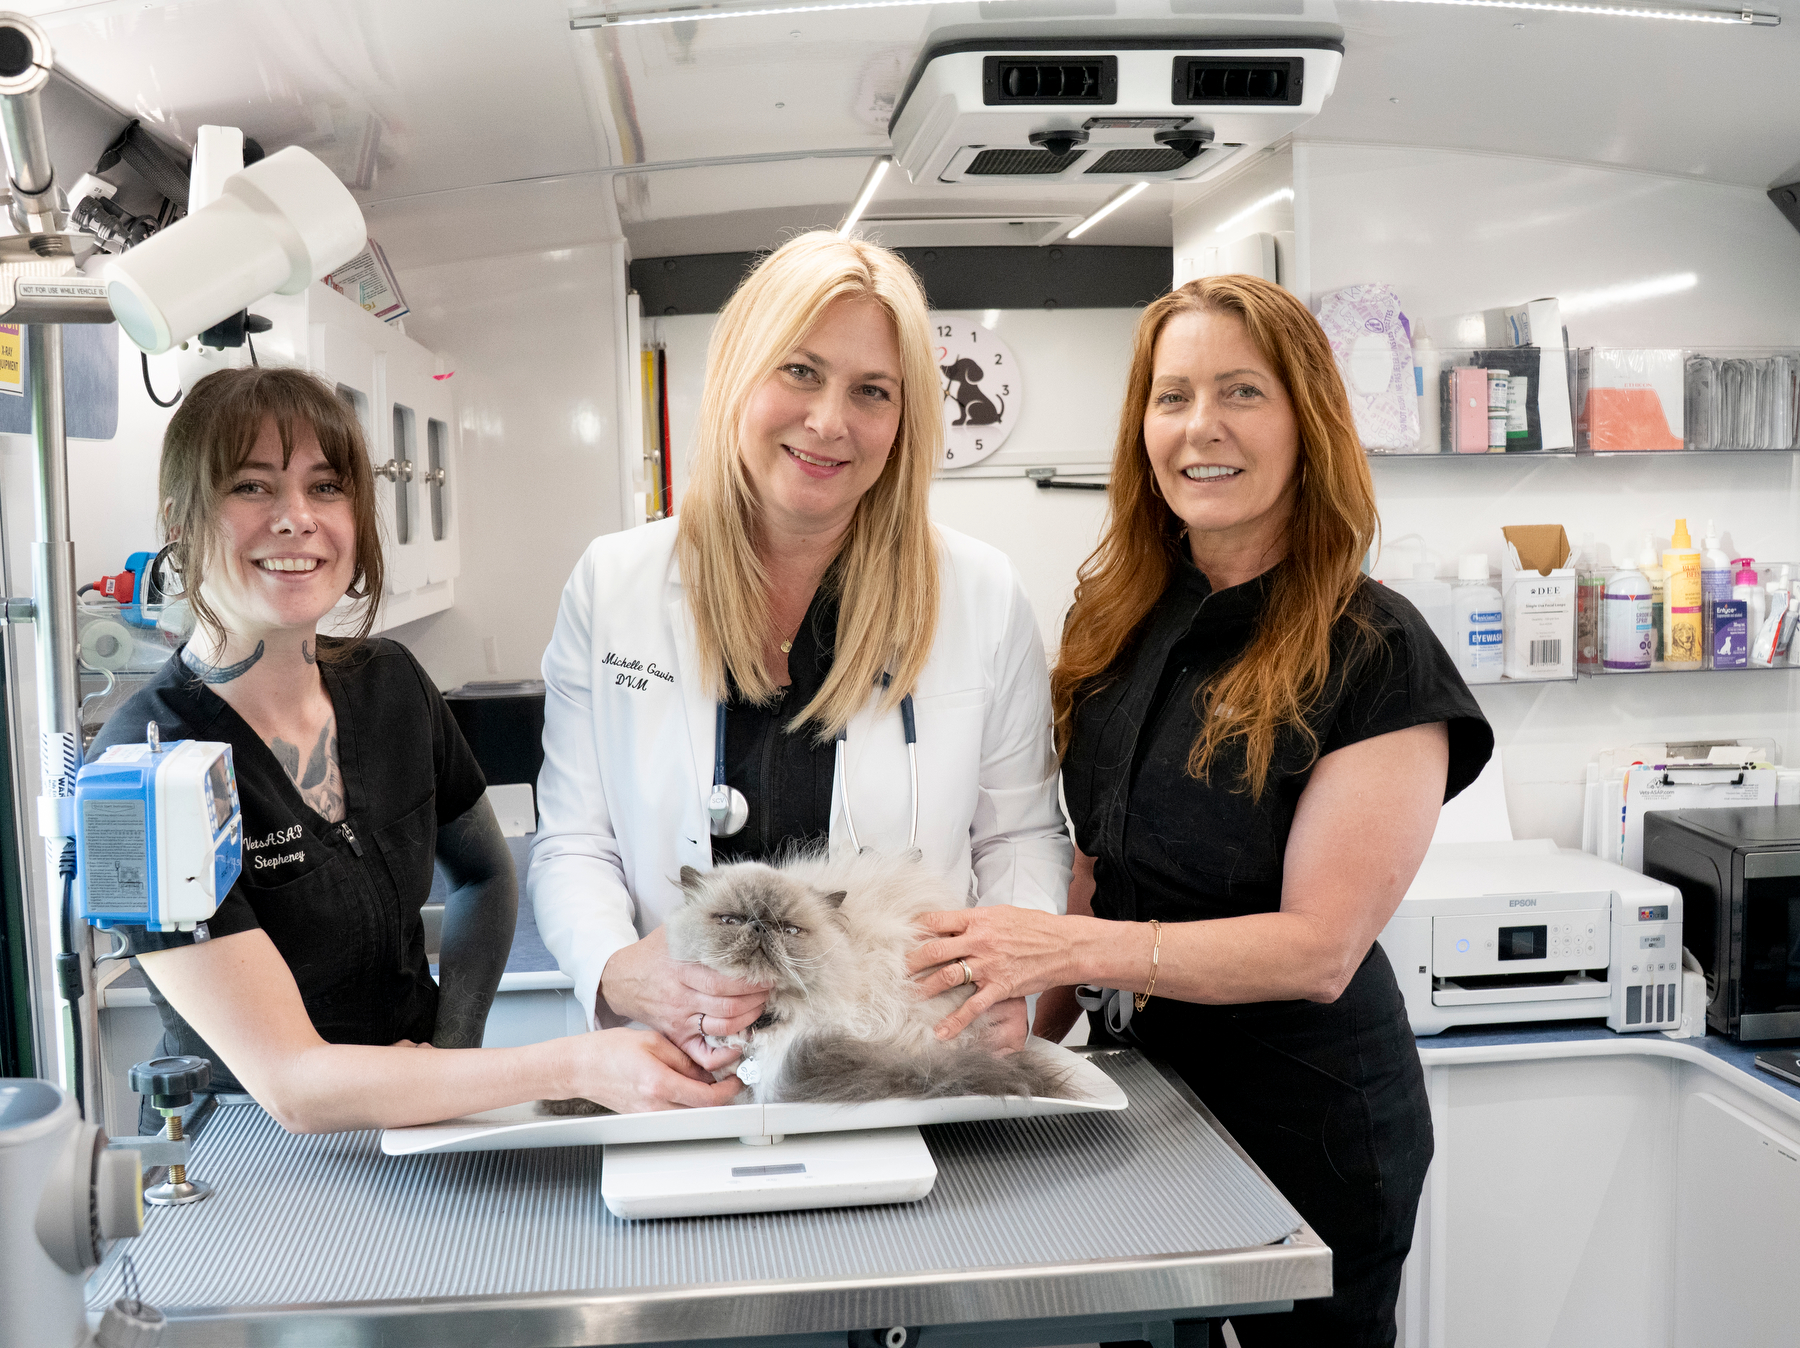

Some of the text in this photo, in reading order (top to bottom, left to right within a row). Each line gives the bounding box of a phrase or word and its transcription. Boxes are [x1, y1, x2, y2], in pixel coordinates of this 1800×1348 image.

[60, 287, 75, 295] WHILE
[77, 288, 97, 296] VEHICLE
[937, 325, 952, 337] 12
[971, 331, 977, 342] 1
[1, 345, 13, 357] X-RAY
[995, 354, 1002, 365] 2
[1002, 384, 1009, 396] 3
[975, 439, 983, 450] 5
[947, 449, 954, 460] 6
[1538, 587, 1561, 595] DEE
[602, 652, 674, 683] Michelle Gavin
[615, 673, 649, 691] DVM
[1509, 899, 1537, 908] EPSON
